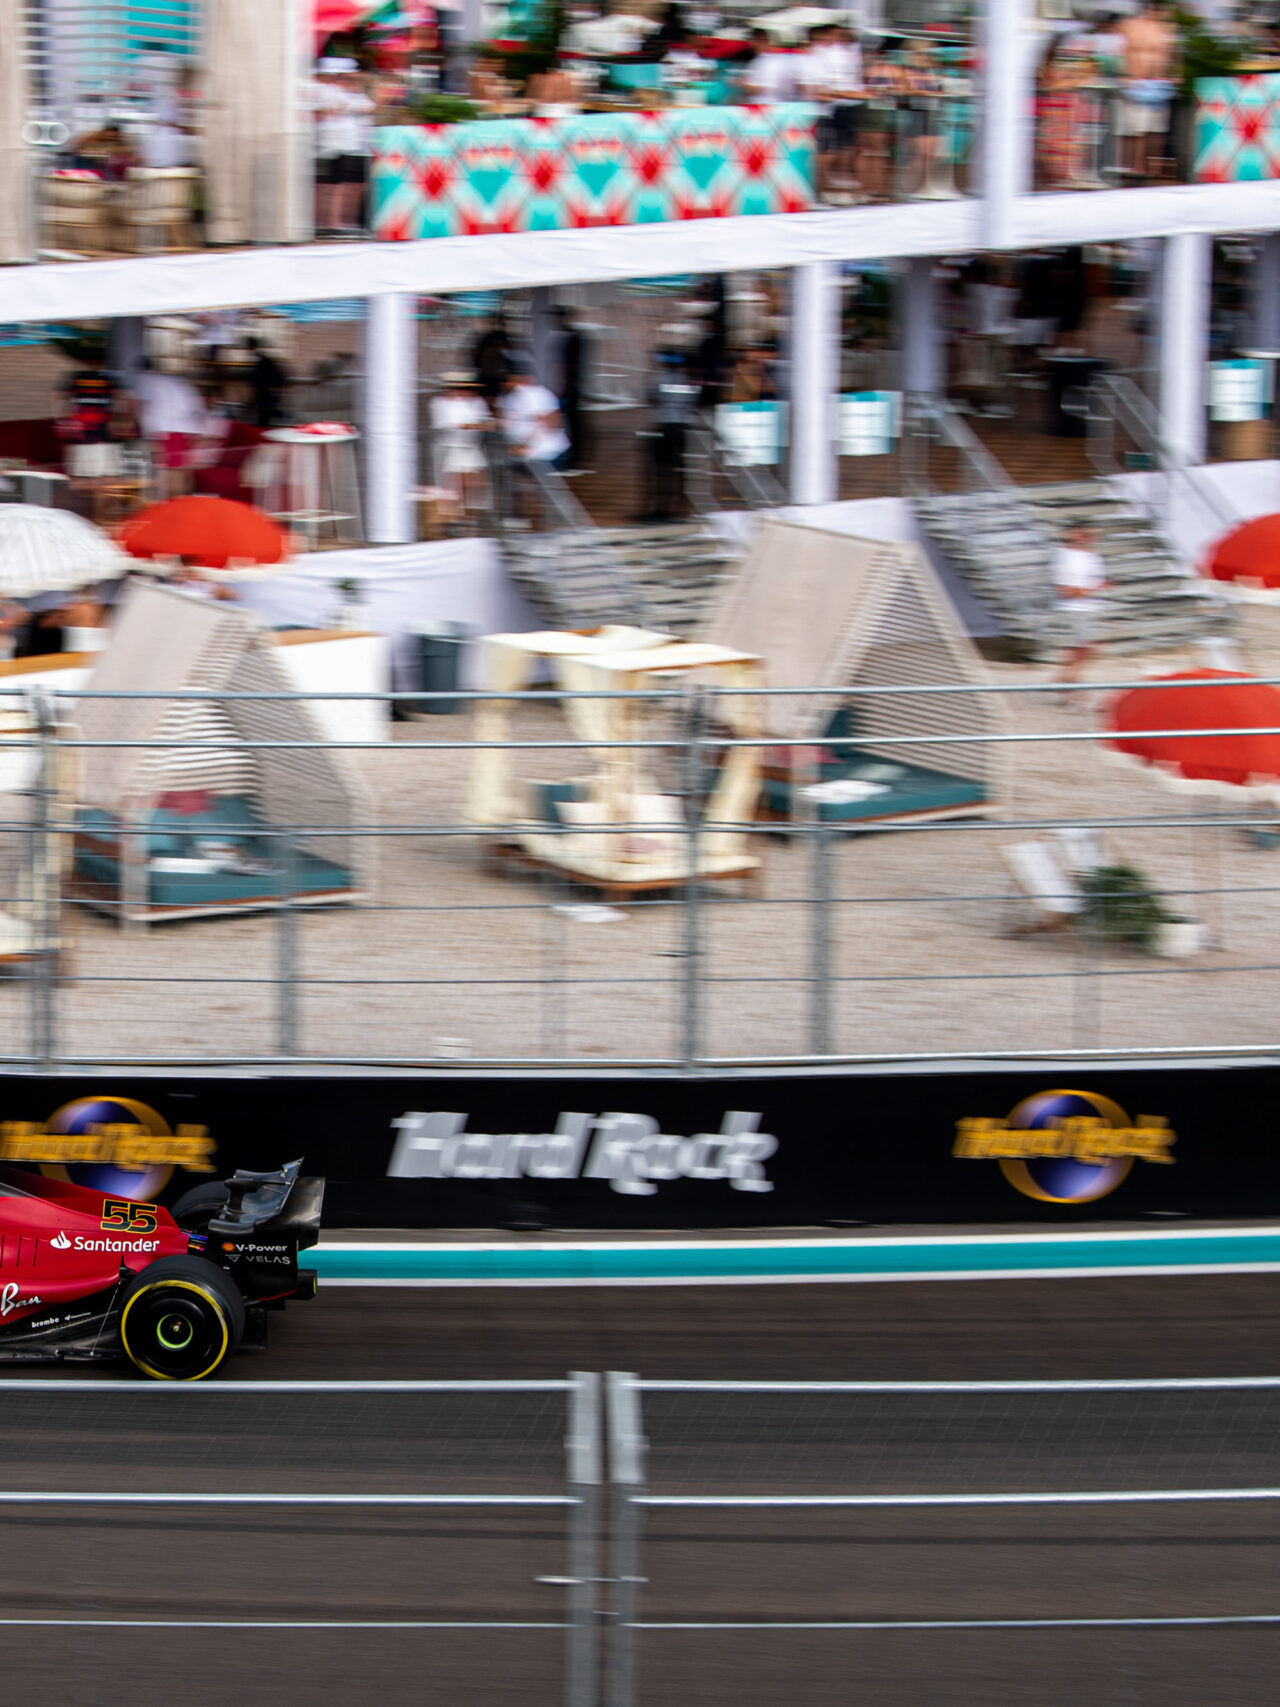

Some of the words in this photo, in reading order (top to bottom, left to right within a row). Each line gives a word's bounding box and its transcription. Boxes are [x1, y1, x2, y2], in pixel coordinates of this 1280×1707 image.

[386, 1111, 596, 1179] Hard
[582, 1111, 780, 1196] Rock
[100, 1198, 158, 1235] 55
[74, 1236, 160, 1252] Santander
[235, 1244, 288, 1252] V-Power
[245, 1255, 291, 1265] VELAS
[31, 1317, 59, 1328] brembo
